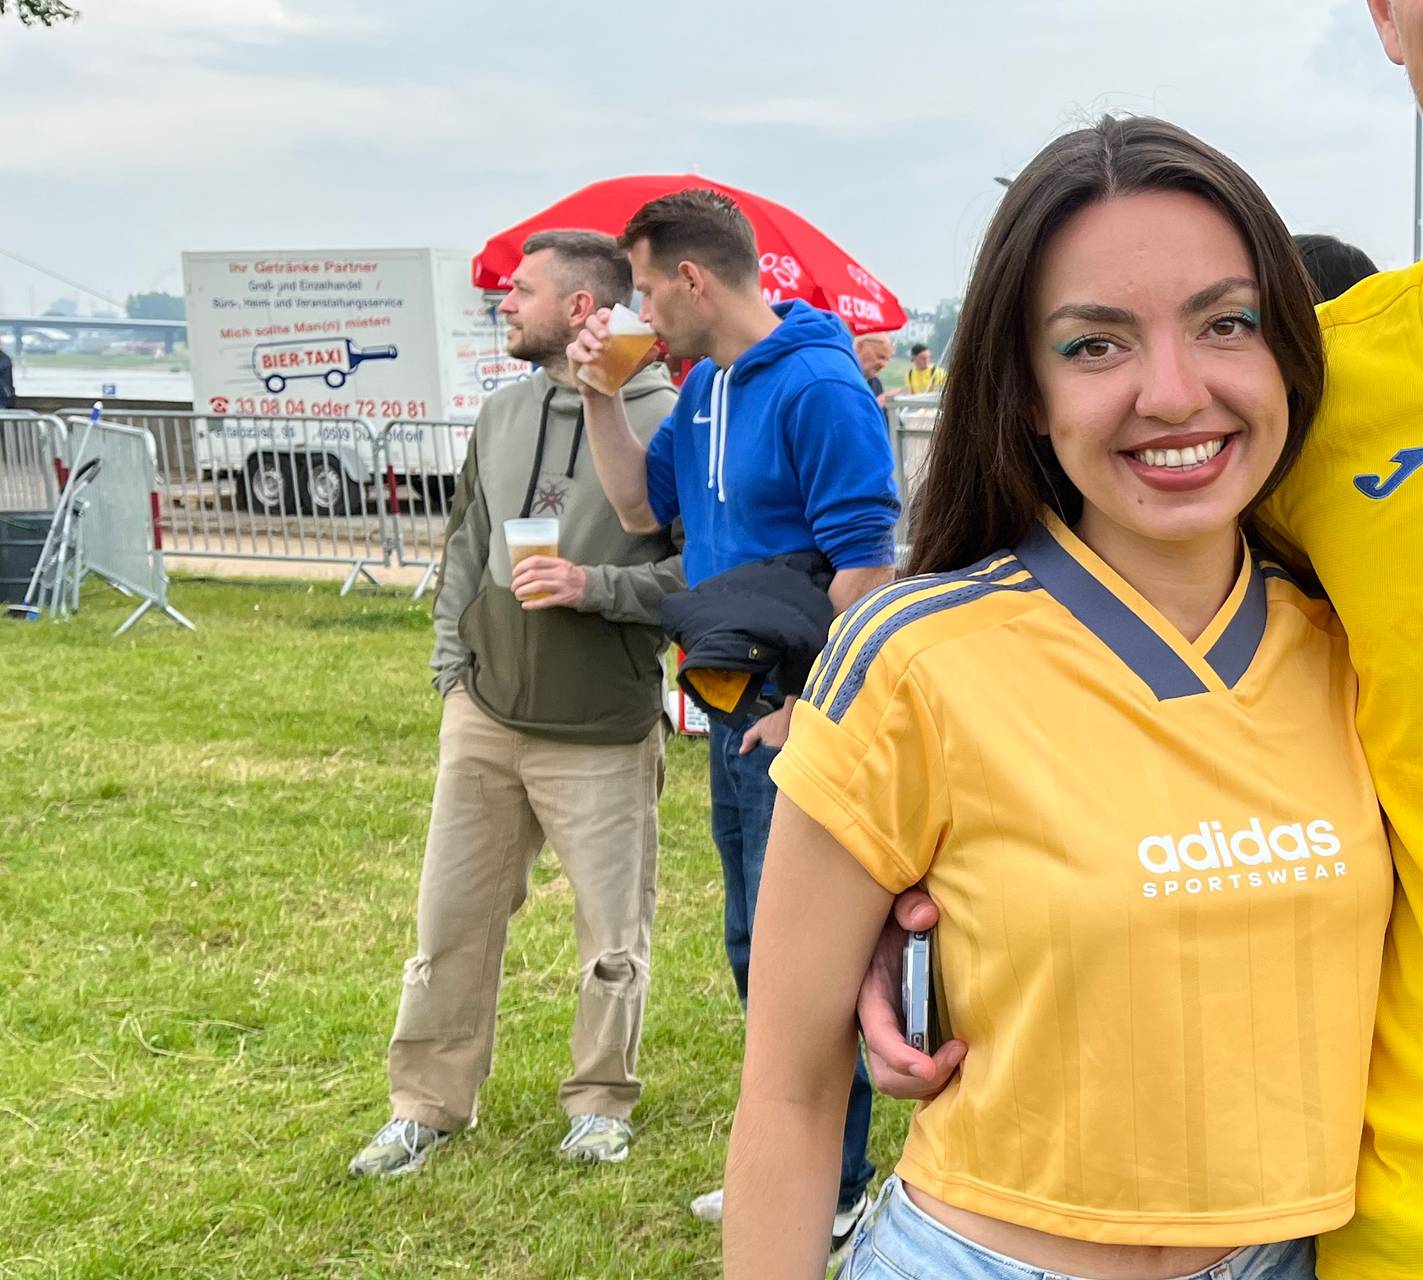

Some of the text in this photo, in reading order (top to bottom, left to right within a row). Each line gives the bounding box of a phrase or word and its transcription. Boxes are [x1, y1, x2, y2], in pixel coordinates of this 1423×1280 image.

[229, 260, 379, 274] Ihr Getränke Partner
[294, 319, 341, 334] Man(n)
[344, 315, 391, 329] mieten
[262, 349, 343, 369] BIER-TAXI
[236, 399, 427, 418] 33 08 04 oder 72 20 81
[1137, 817, 1341, 874] adidas
[1143, 861, 1348, 898] SPORTSWEAR
